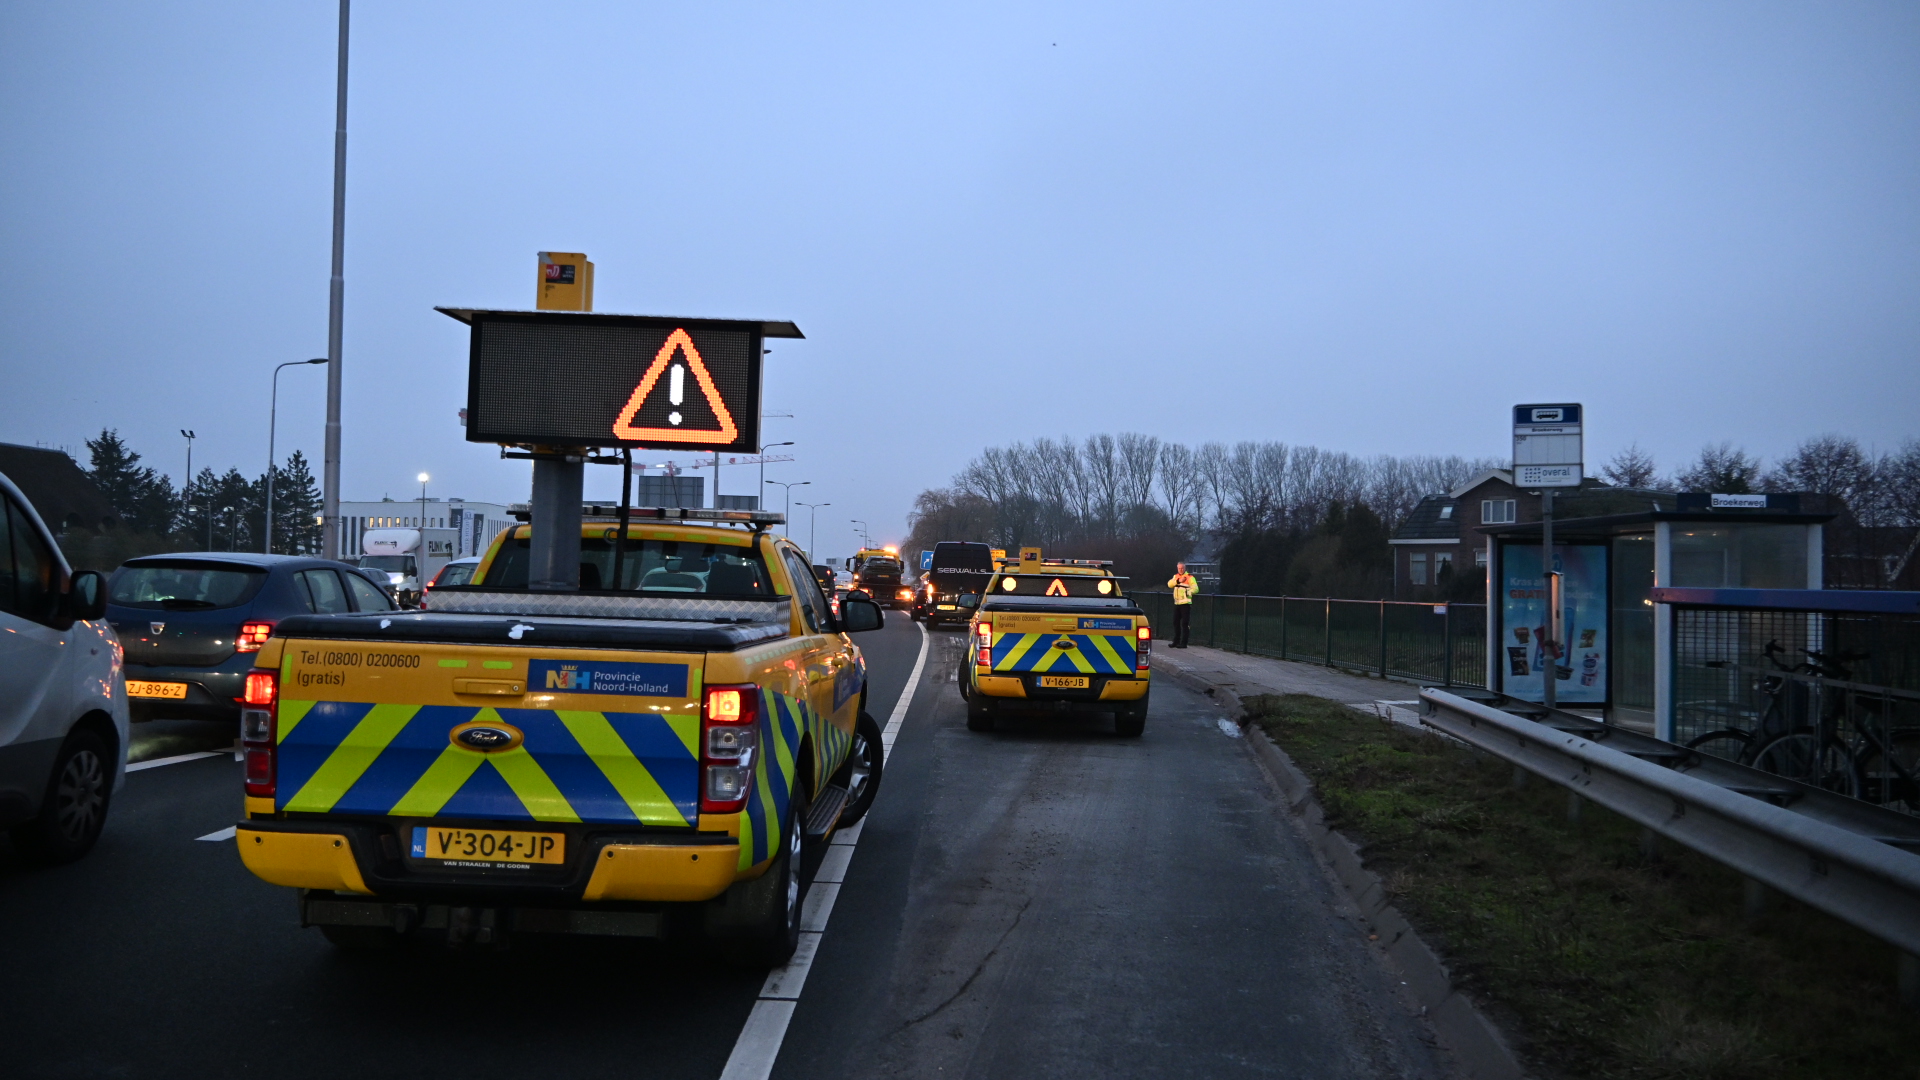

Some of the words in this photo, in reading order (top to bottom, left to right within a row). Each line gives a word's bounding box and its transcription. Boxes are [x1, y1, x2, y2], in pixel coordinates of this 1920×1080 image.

[1542, 467, 1571, 476] overal
[1713, 498, 1765, 507] Broekerweg
[428, 540, 444, 552] FLINK
[1509, 589, 1546, 599] GRATI
[366, 653, 420, 668] 0200600
[297, 670, 345, 687] (gratis)
[594, 671, 641, 682] Provincie
[1045, 677, 1084, 687] V-166-JB
[128, 683, 182, 697] ZJ-896-Z
[593, 682, 669, 693] Noord-Holland
[469, 730, 498, 743] Ford
[413, 845, 424, 853] NL
